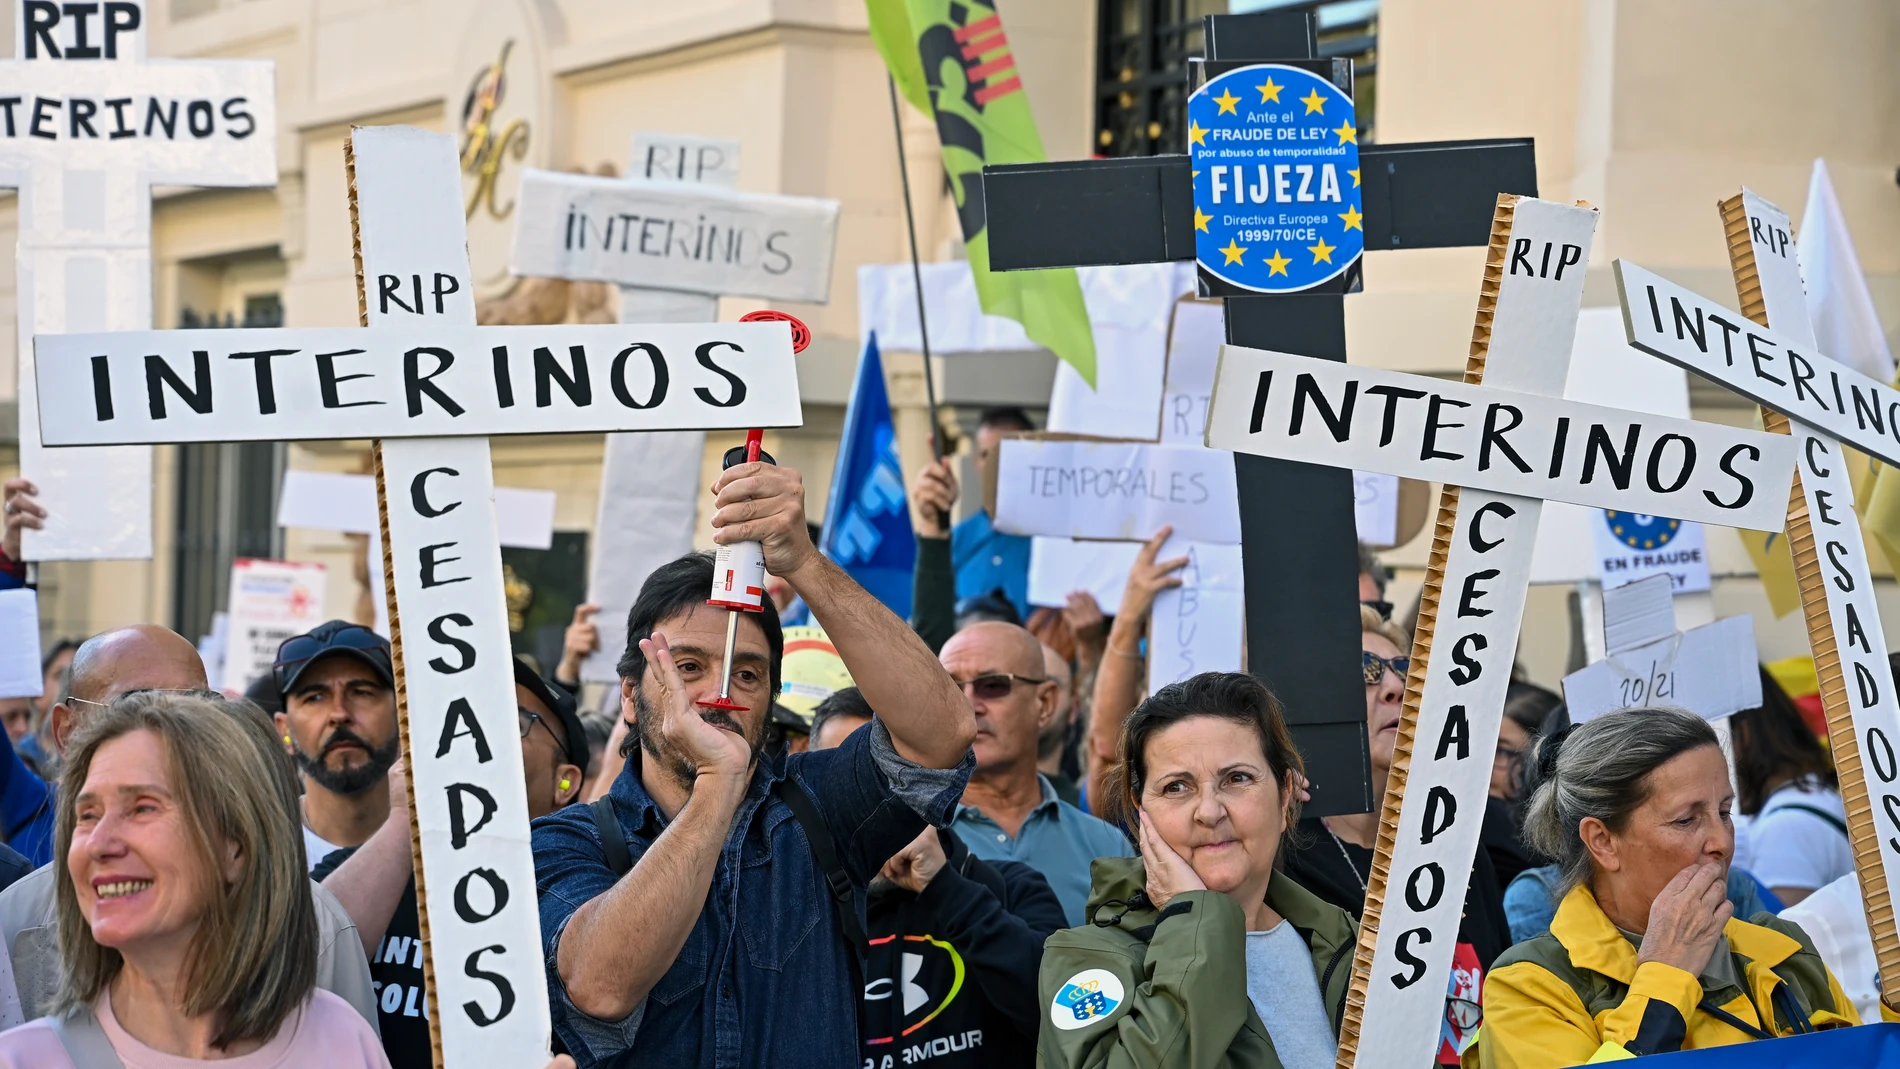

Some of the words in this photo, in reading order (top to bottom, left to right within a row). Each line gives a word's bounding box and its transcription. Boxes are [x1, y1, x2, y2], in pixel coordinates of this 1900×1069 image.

[23, 0, 141, 59] RIP
[1212, 128, 1273, 141] FRAUDE
[1276, 128, 1297, 140] DE
[1301, 127, 1328, 140] LEY
[1246, 111, 1278, 124] Ante
[1281, 111, 1294, 123] el
[644, 143, 725, 182] RIP
[1198, 149, 1216, 160] por
[1219, 148, 1254, 158] abuso
[1256, 147, 1271, 157] de
[1272, 146, 1346, 159] temporalidad
[1210, 163, 1342, 205] FIJEZA
[1223, 214, 1276, 226] Directiva
[1278, 214, 1329, 227] Europea
[1236, 227, 1317, 242] 1999/70/CE
[1750, 215, 1791, 260] RIP
[1509, 237, 1583, 284] RIP
[377, 271, 461, 316] RIP
[90, 340, 748, 422] INTERINOS
[1172, 393, 1212, 438] RI
[1247, 369, 1762, 510] INTERINOS
[1028, 465, 1210, 505] TEMPORALES
[1603, 558, 1628, 572] EN
[1633, 548, 1702, 569] FRAUDE
[426, 466, 517, 1029] CESADOS
[1390, 500, 1517, 991] CESADOS
